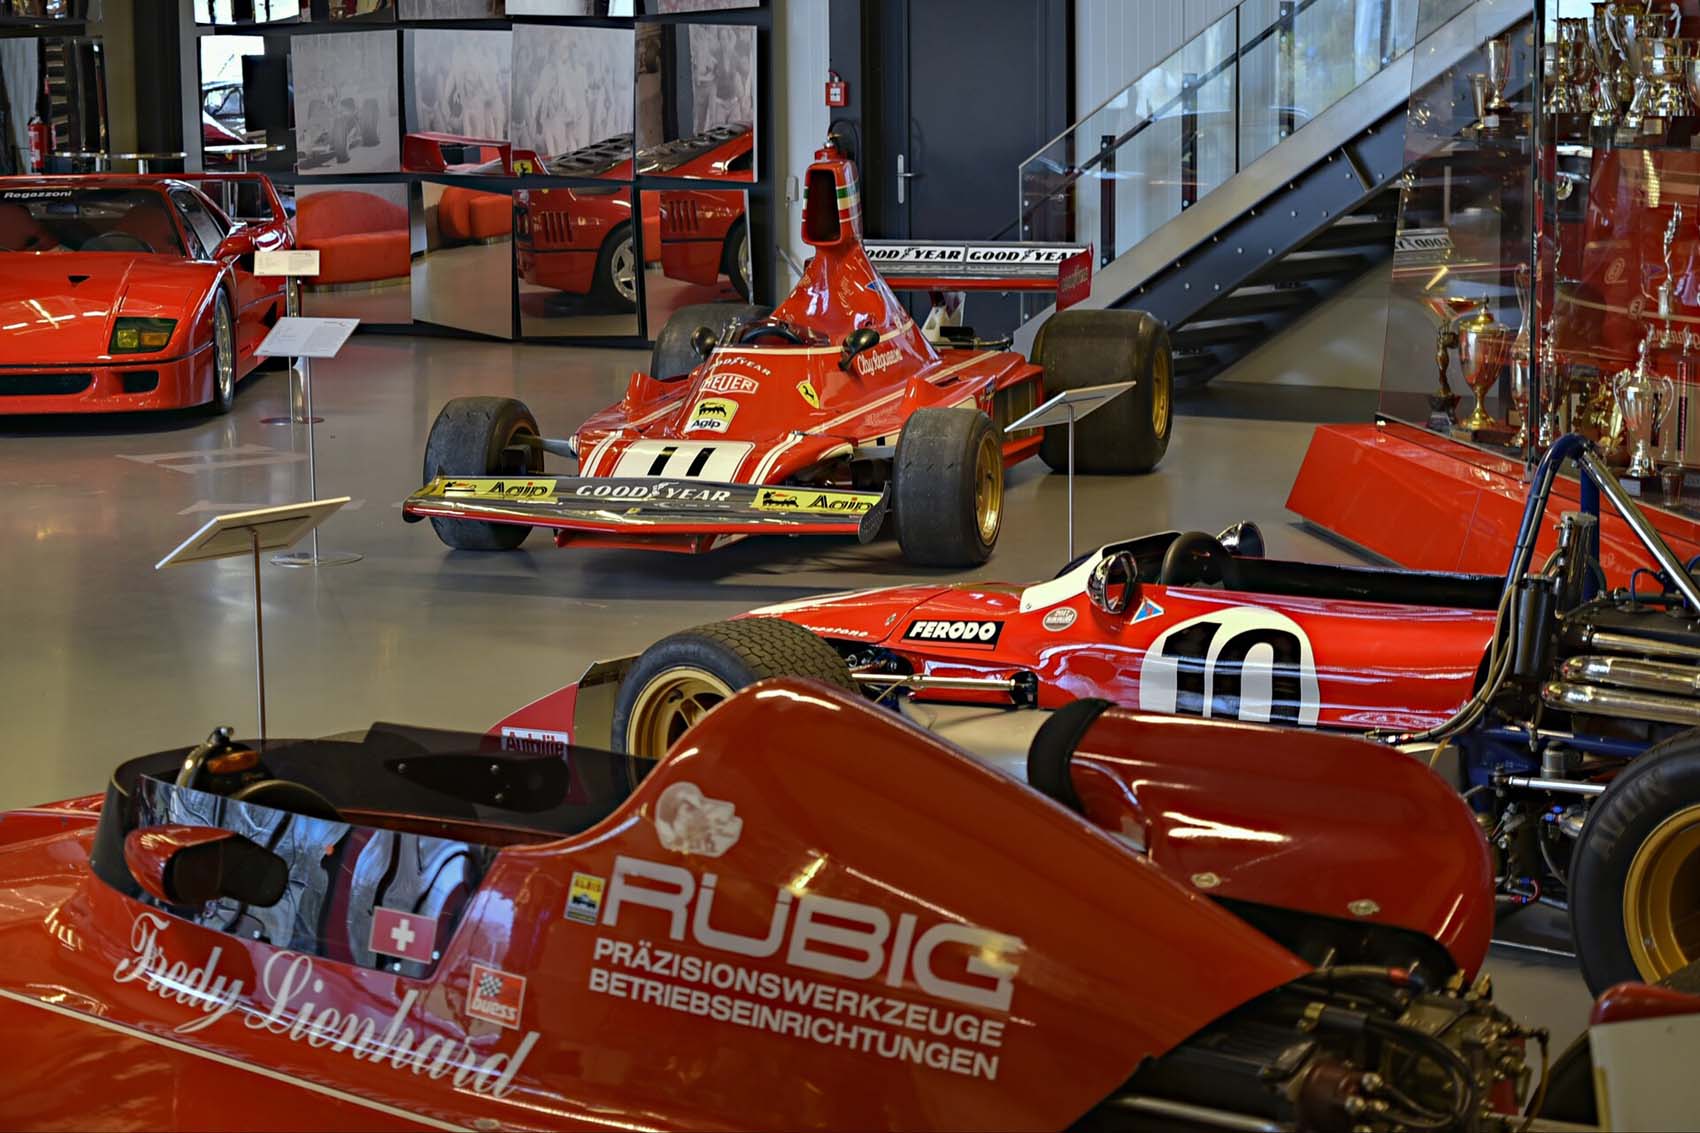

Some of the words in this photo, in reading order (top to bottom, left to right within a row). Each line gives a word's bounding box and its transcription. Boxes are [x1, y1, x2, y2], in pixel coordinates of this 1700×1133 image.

[3, 190, 73, 199] Regazzoni
[866, 248, 900, 260] OOD
[914, 248, 962, 261] YEAR
[969, 249, 1020, 262] GOOD
[1032, 251, 1078, 262] YEA
[703, 375, 753, 392] HEUER
[691, 419, 721, 429] Agip
[647, 446, 717, 477] 11
[488, 481, 548, 497] Agip
[575, 485, 649, 498] GOOD
[664, 487, 731, 502] YEAR
[808, 494, 873, 511] Agip
[801, 624, 869, 638] irestone
[908, 620, 997, 641] FERODO
[1161, 620, 1302, 724] 10
[593, 937, 1006, 1048] PRÄZISIONSWERKZEUGE
[112, 911, 245, 1034] Fredy
[244, 950, 541, 1099] Lienhard
[588, 967, 1000, 1081] BETRIEBSEINRICHTUNGEN
